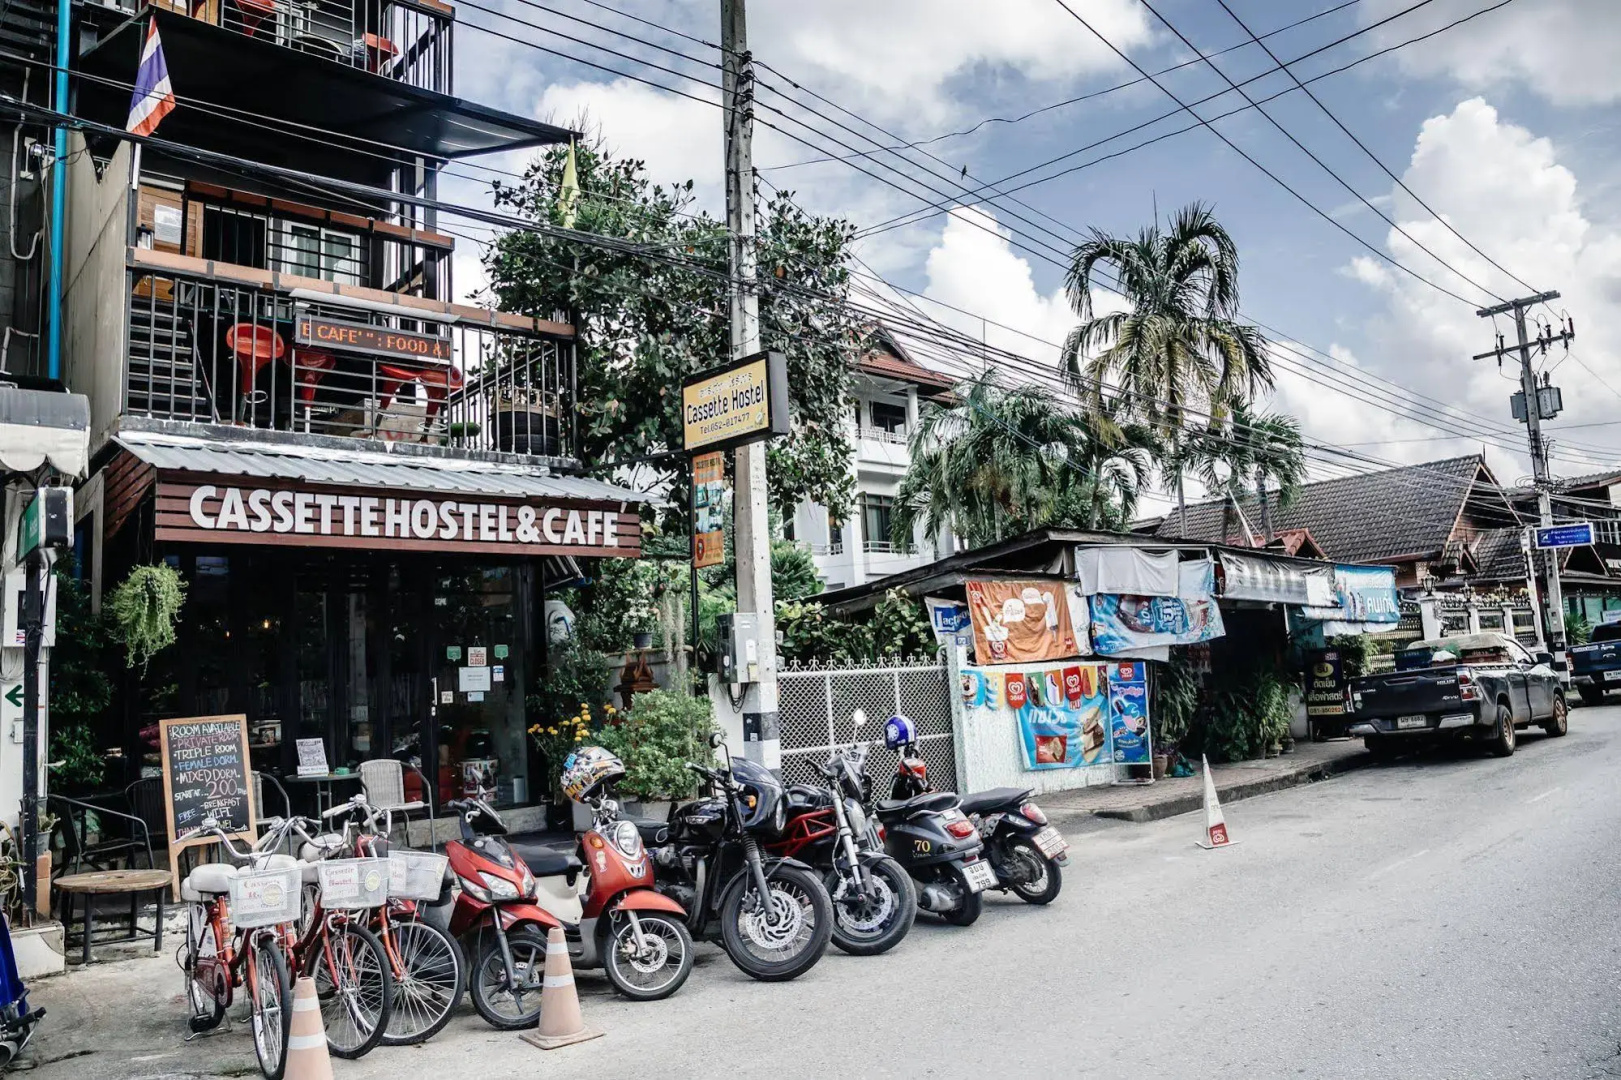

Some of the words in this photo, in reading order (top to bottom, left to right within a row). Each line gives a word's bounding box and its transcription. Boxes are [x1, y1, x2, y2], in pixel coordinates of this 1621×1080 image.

[387, 335, 428, 354] FOOD
[686, 394, 728, 425] Cassette
[731, 379, 764, 411] Hostel
[171, 725, 200, 738] ROOM
[177, 735, 218, 749] PRIVATE
[175, 746, 212, 760] TRIPLE
[214, 743, 237, 755] ROOM
[179, 757, 212, 771] FEMALE
[179, 769, 212, 785] MIXED
[205, 778, 238, 799] 200
[913, 839, 931, 852] 70
[975, 877, 992, 889] 799
